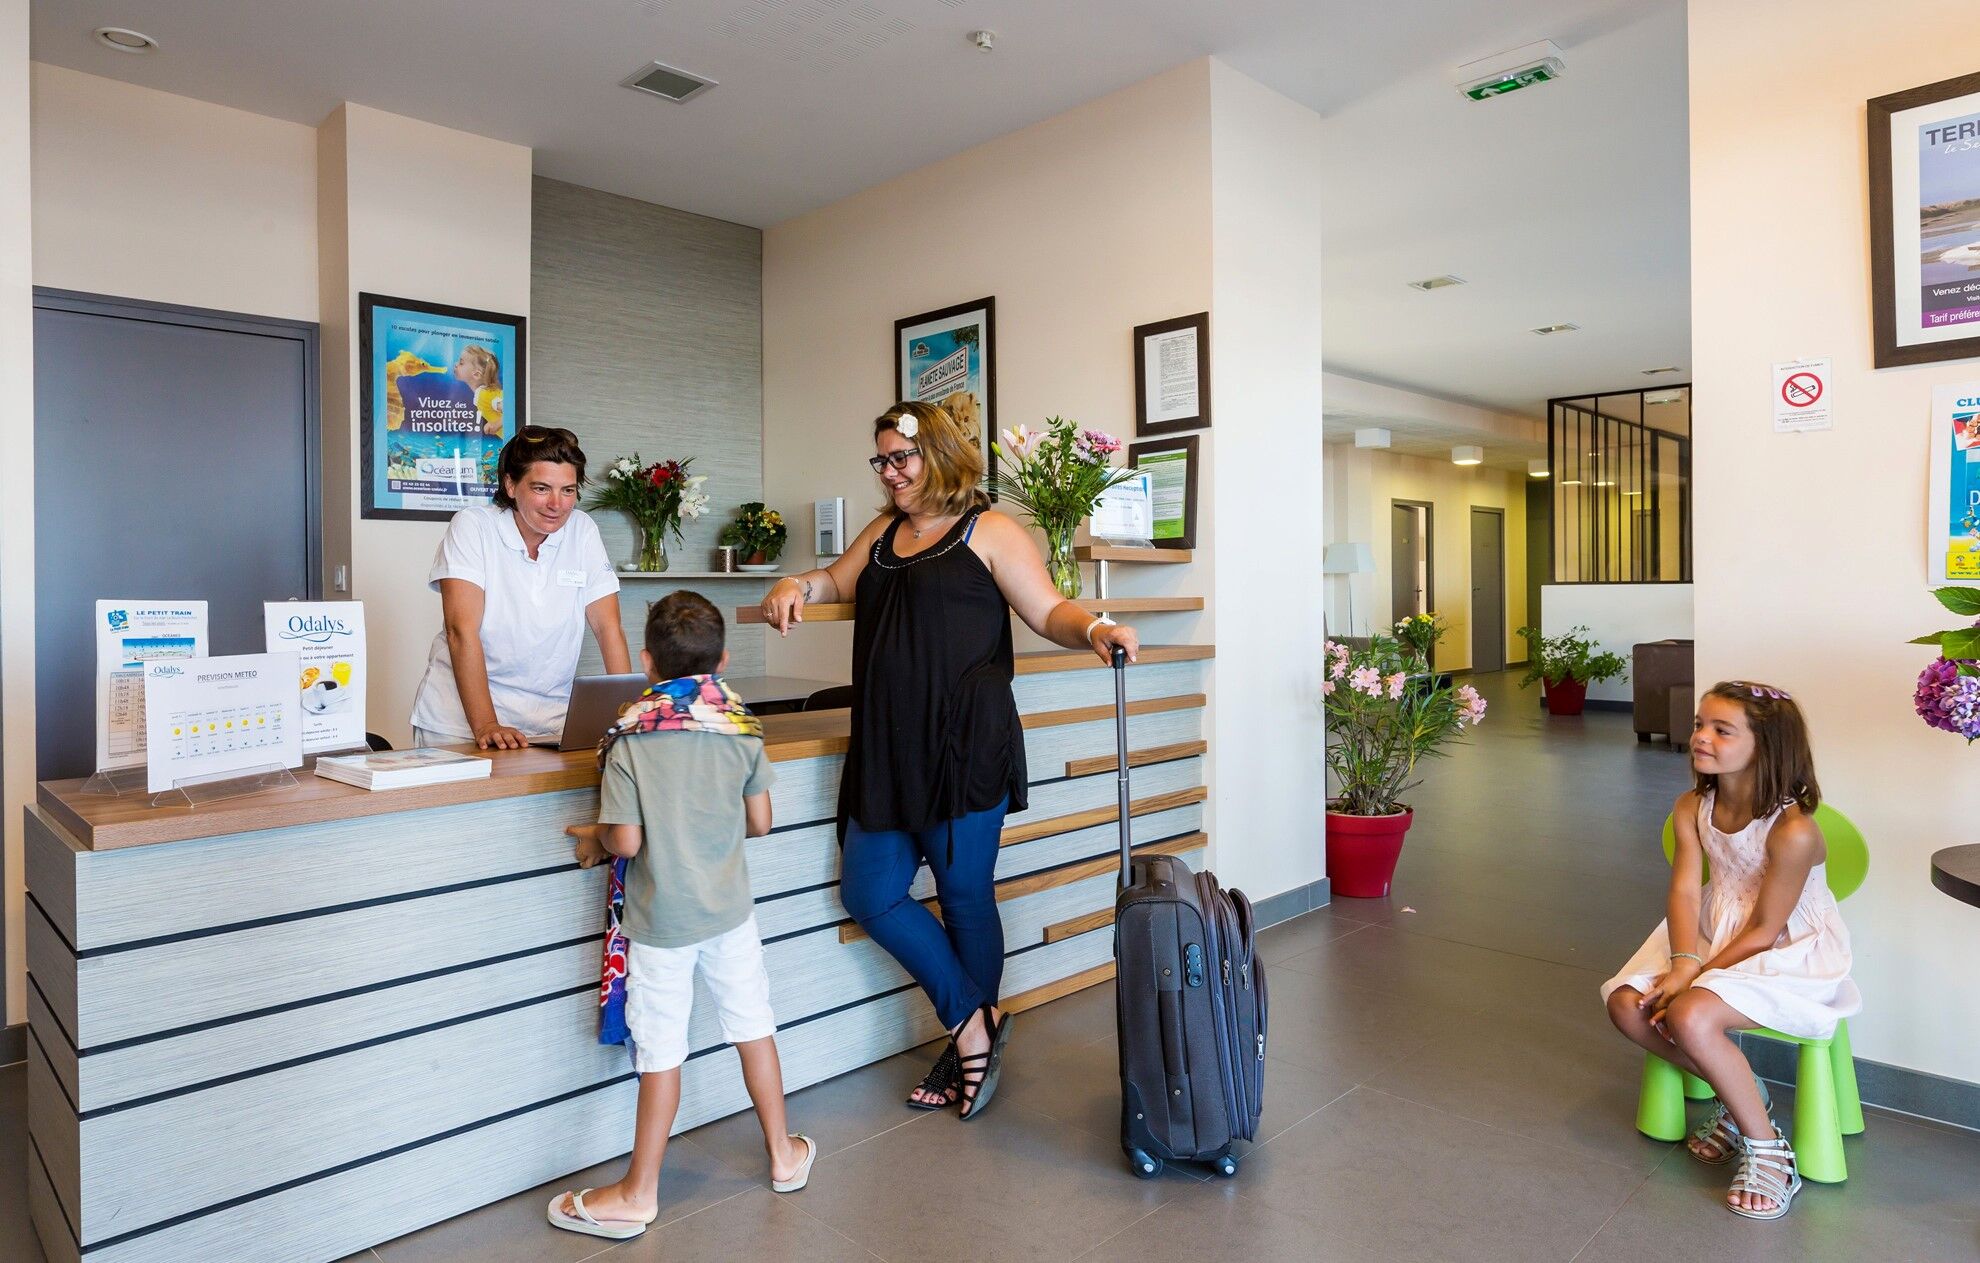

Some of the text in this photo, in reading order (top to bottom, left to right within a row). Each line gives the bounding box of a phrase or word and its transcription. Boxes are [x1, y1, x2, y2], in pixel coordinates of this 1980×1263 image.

[1925, 120, 1980, 145] TER
[1932, 287, 1961, 296] Venez
[1930, 313, 1948, 323] Tarif
[418, 397, 452, 408] Vivez
[410, 408, 474, 419] rencontres
[421, 462, 474, 475] Océarum
[286, 615, 346, 637] Odalys
[152, 665, 182, 676] Odalys
[197, 670, 258, 682] PREVISION METEO
